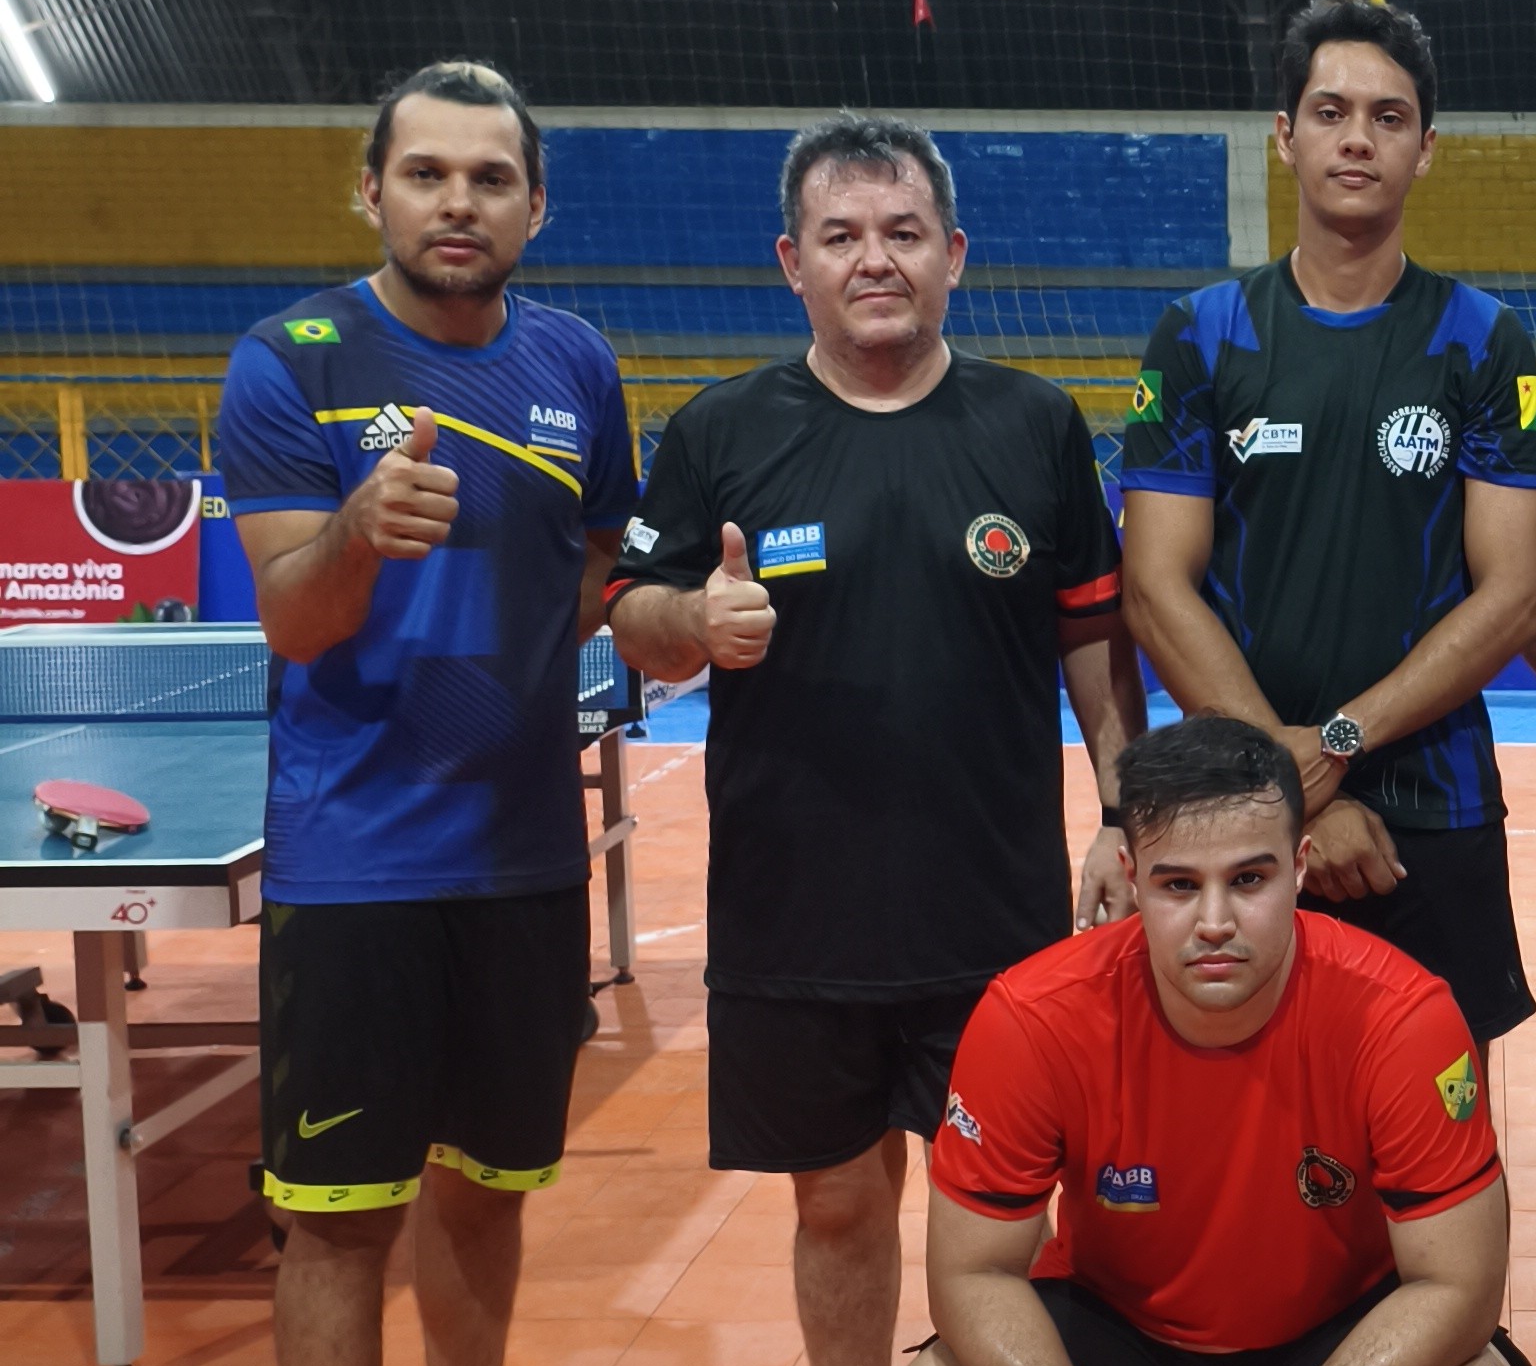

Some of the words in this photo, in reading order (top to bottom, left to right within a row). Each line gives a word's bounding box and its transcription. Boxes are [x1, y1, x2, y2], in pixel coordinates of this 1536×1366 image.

[529, 404, 577, 431] AABB
[360, 431, 414, 451] adid
[1262, 429, 1298, 439] CBTM
[1387, 405, 1428, 423] ACREANA
[1430, 408, 1441, 420] DE
[1441, 447, 1450, 459] DE
[1394, 435, 1439, 451] AATM
[763, 525, 820, 549] AABB
[72, 559, 123, 579] viva
[5, 579, 125, 600] Amazônia
[1103, 1165, 1153, 1186] AABB
